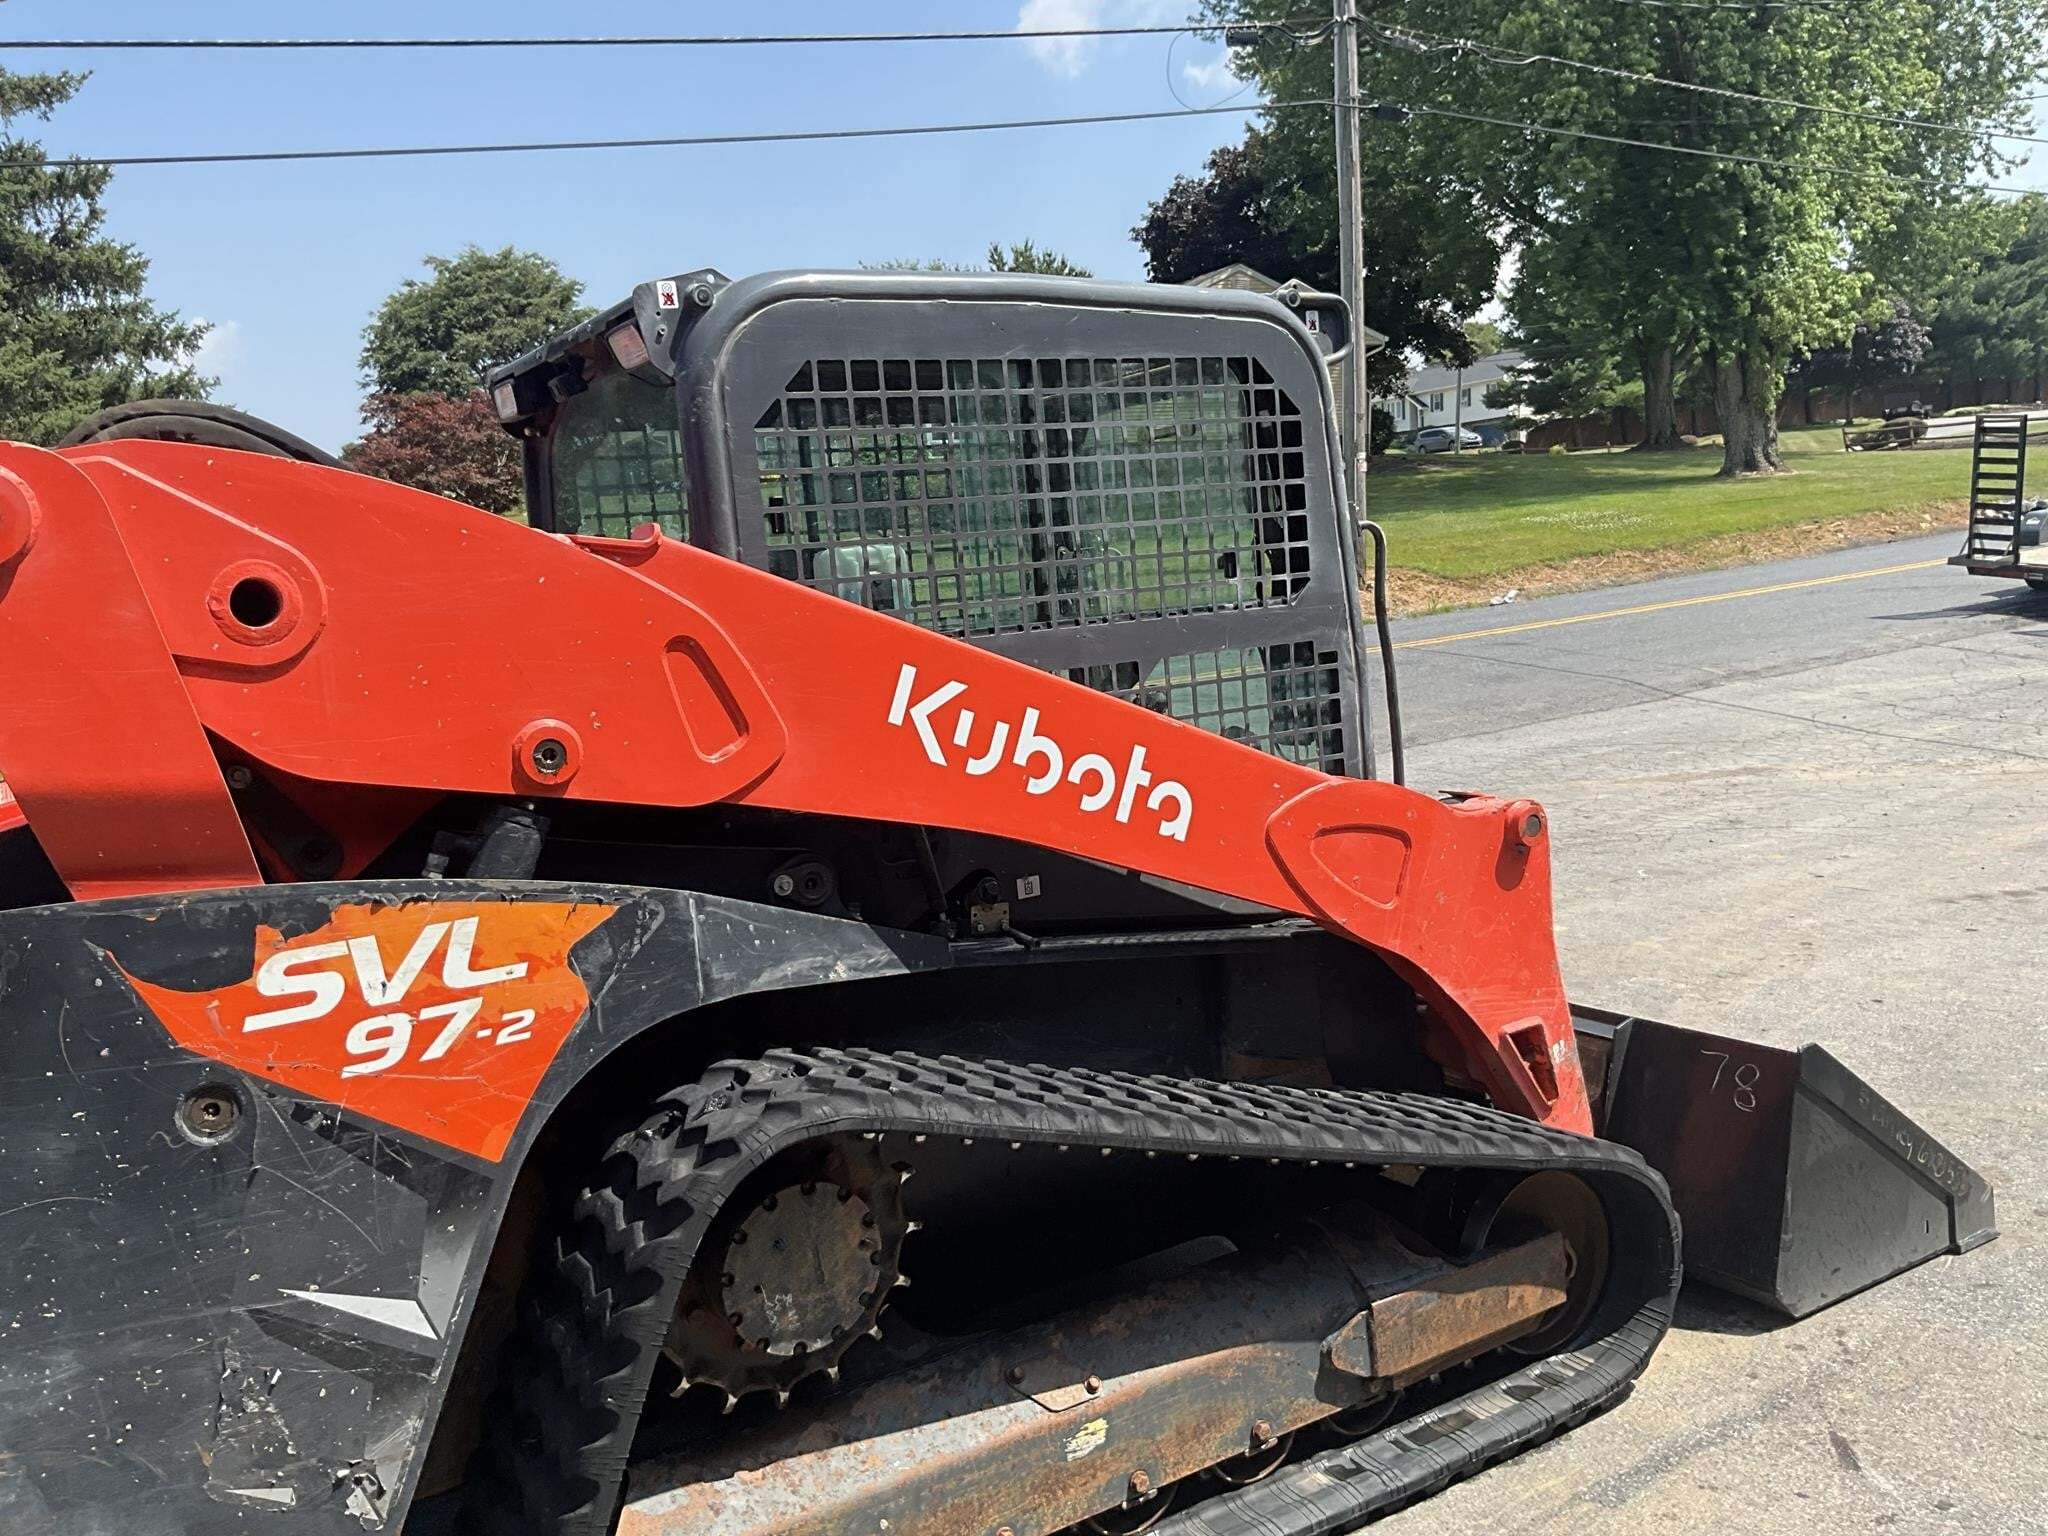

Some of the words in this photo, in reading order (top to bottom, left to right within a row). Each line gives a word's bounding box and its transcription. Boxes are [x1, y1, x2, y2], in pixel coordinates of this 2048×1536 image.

[887, 663, 1193, 842] Kubota
[242, 917, 529, 1033] SVL
[341, 996, 536, 1079] 97-2
[1700, 1049, 1760, 1112] 78
